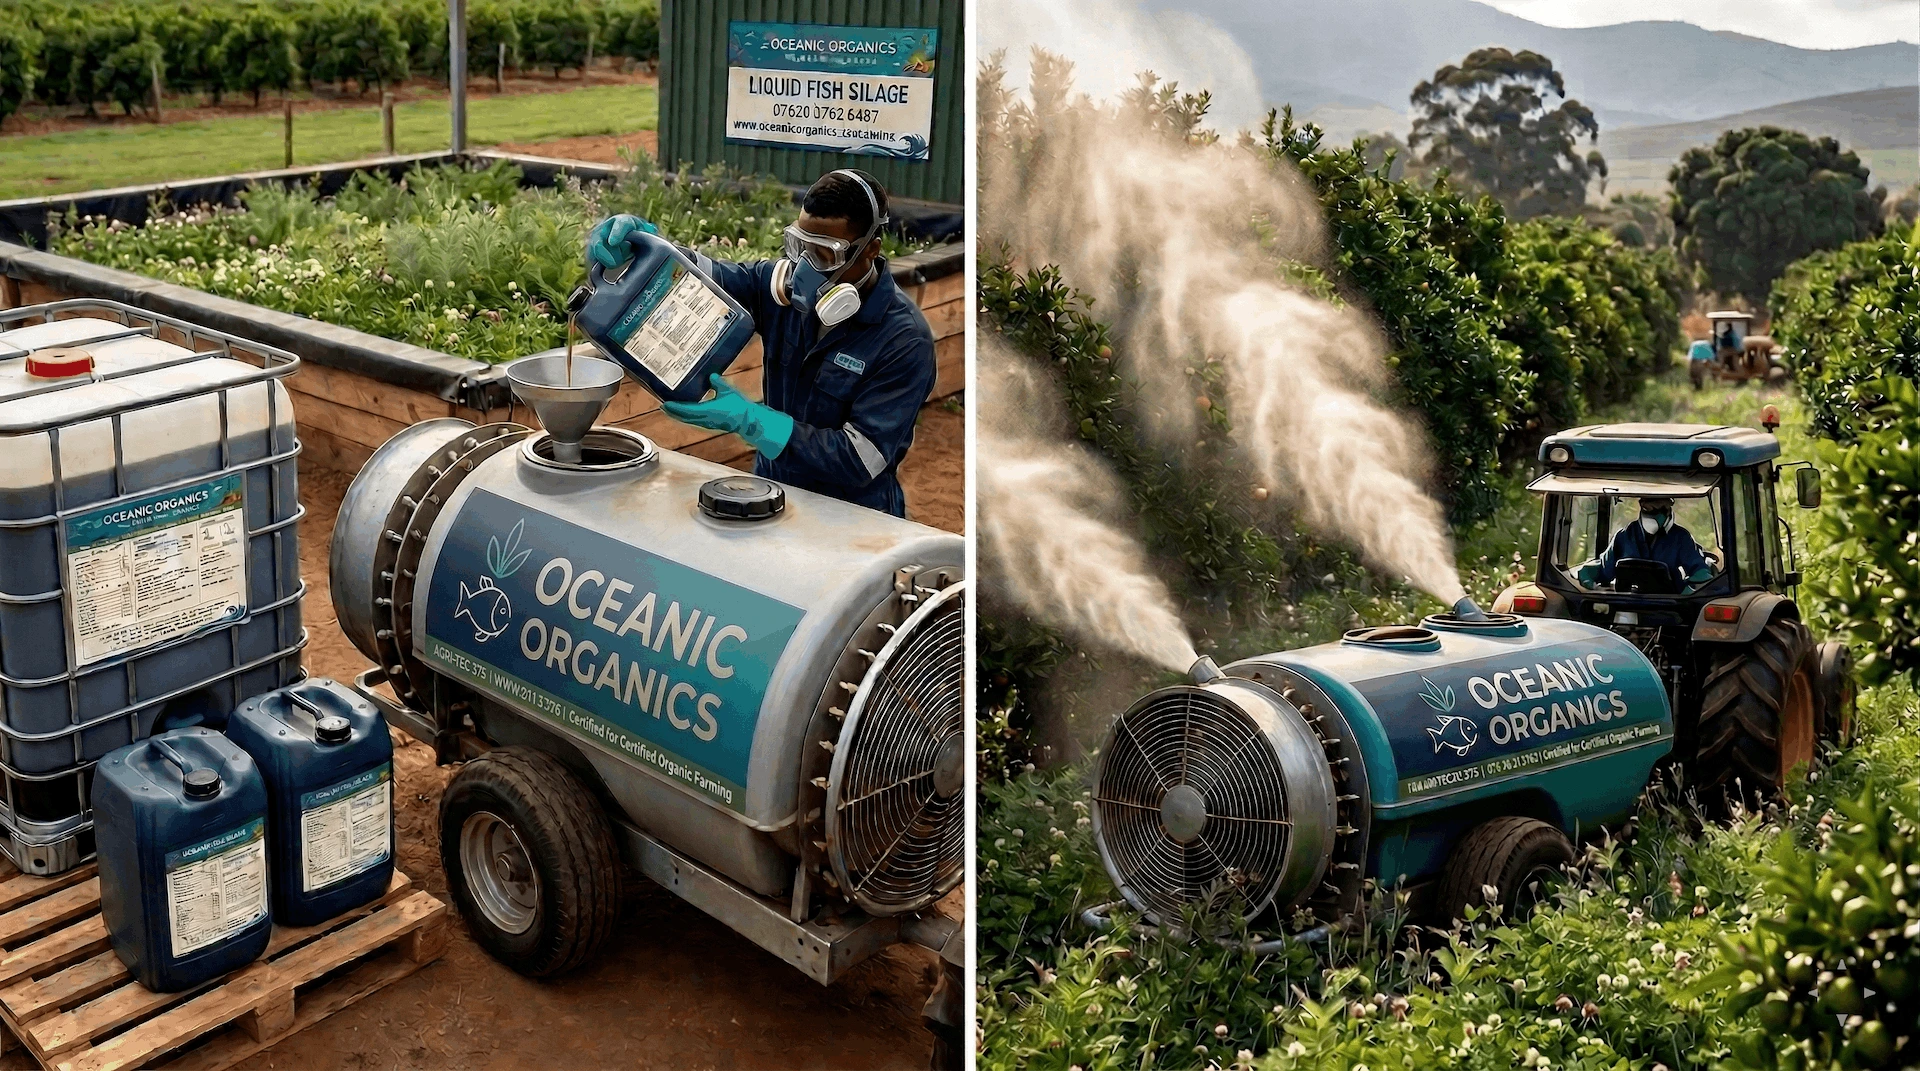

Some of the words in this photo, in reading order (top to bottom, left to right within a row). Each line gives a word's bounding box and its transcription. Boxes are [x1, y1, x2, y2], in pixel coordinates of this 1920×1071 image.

[771, 38, 825, 52] OCEANIC
[828, 40, 897, 55] ORGANICS
[749, 75, 801, 97] LIQUID
[807, 80, 843, 100] FISH
[848, 82, 909, 104] SILAGE
[773, 103, 810, 119] 07620
[847, 108, 879, 124] 6487
[103, 504, 153, 525] OCEANIC
[154, 490, 209, 513] ORGANICS
[534, 557, 749, 680] OCEANIC
[519, 617, 723, 742] ORGANICS
[1467, 653, 1614, 709] OCEANIC
[433, 644, 471, 672] AGRI-TEC
[472, 662, 487, 680] 375
[568, 710, 604, 738] Certified
[605, 727, 619, 745] for
[619, 735, 657, 764] Certified
[658, 754, 693, 782] Organic
[694, 770, 733, 805] Farming
[1489, 689, 1628, 745] ORGANICS
[1463, 766, 1480, 780] 375
